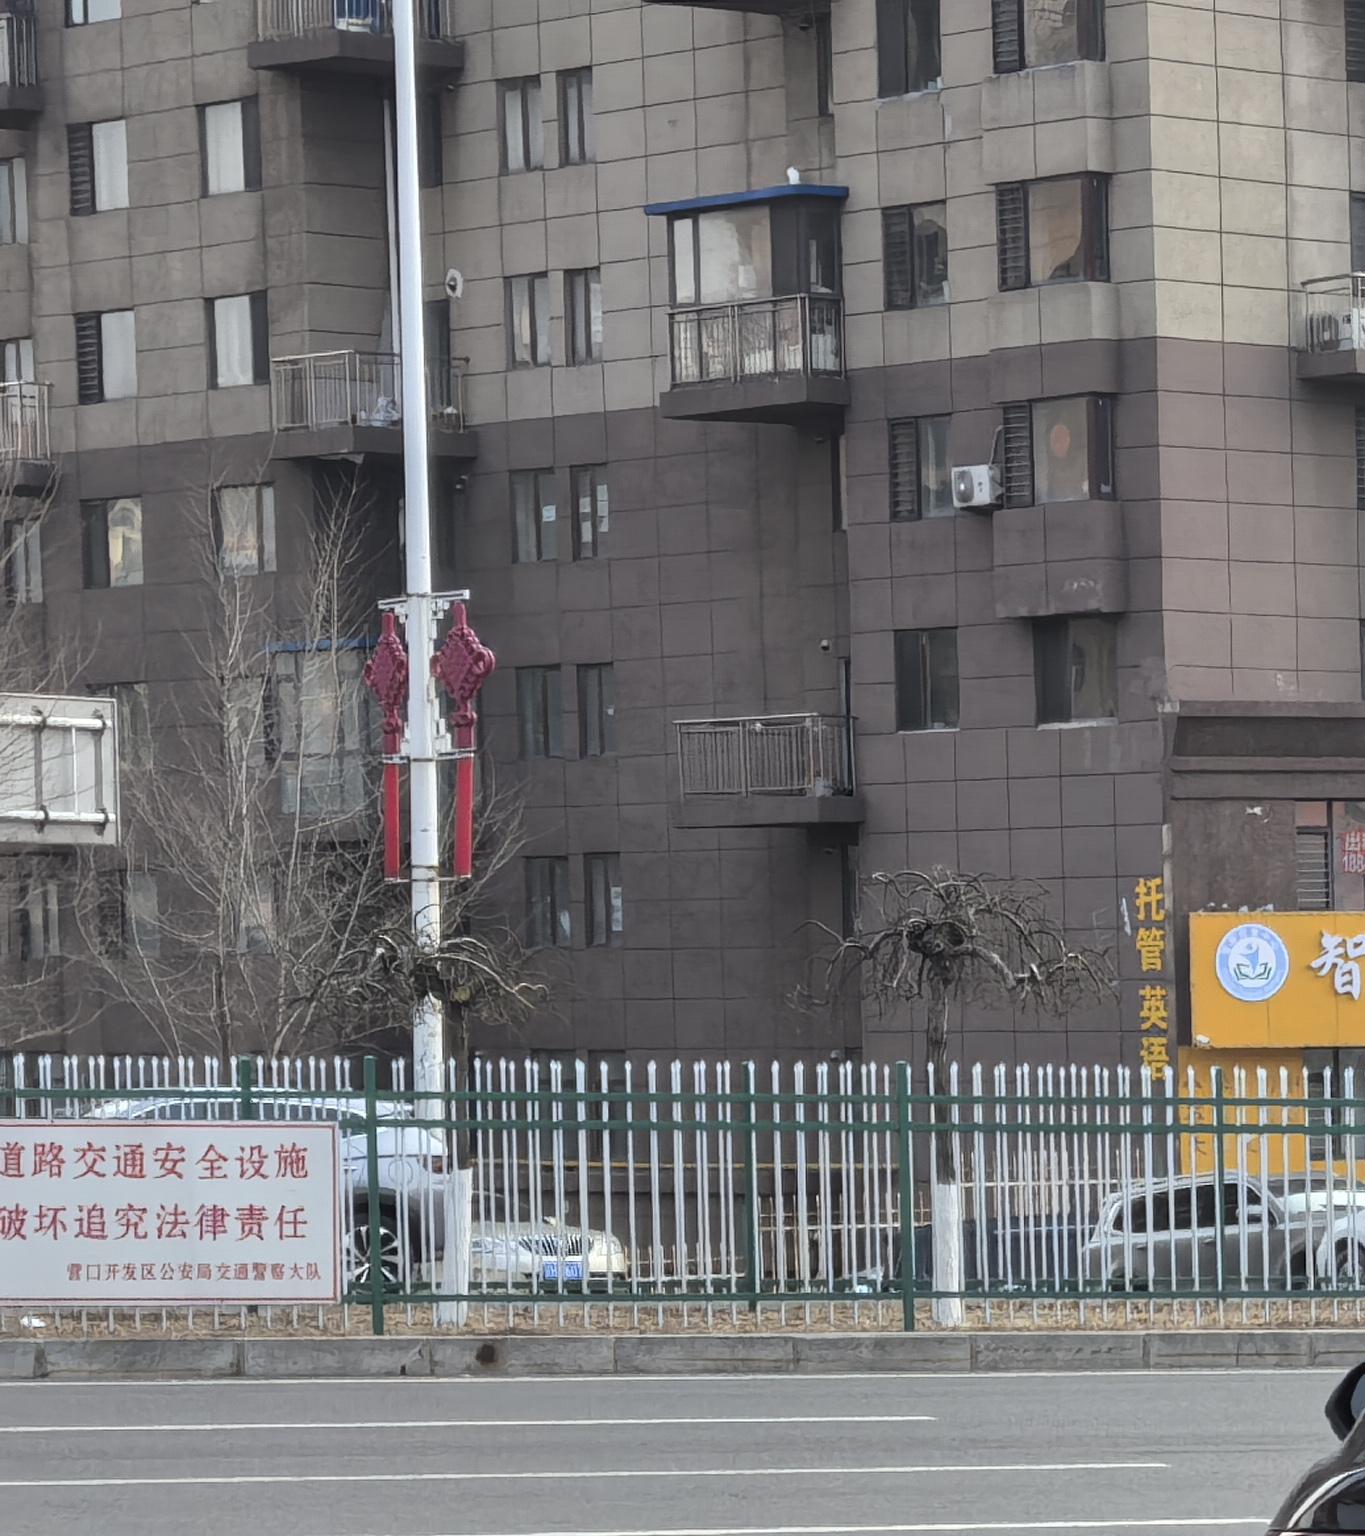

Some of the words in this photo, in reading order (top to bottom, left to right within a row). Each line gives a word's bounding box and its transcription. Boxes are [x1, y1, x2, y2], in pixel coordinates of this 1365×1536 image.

[0, 1141, 310, 1180] 道路交通安全设施
[0, 1202, 310, 1243] 破坏追究法律责任
